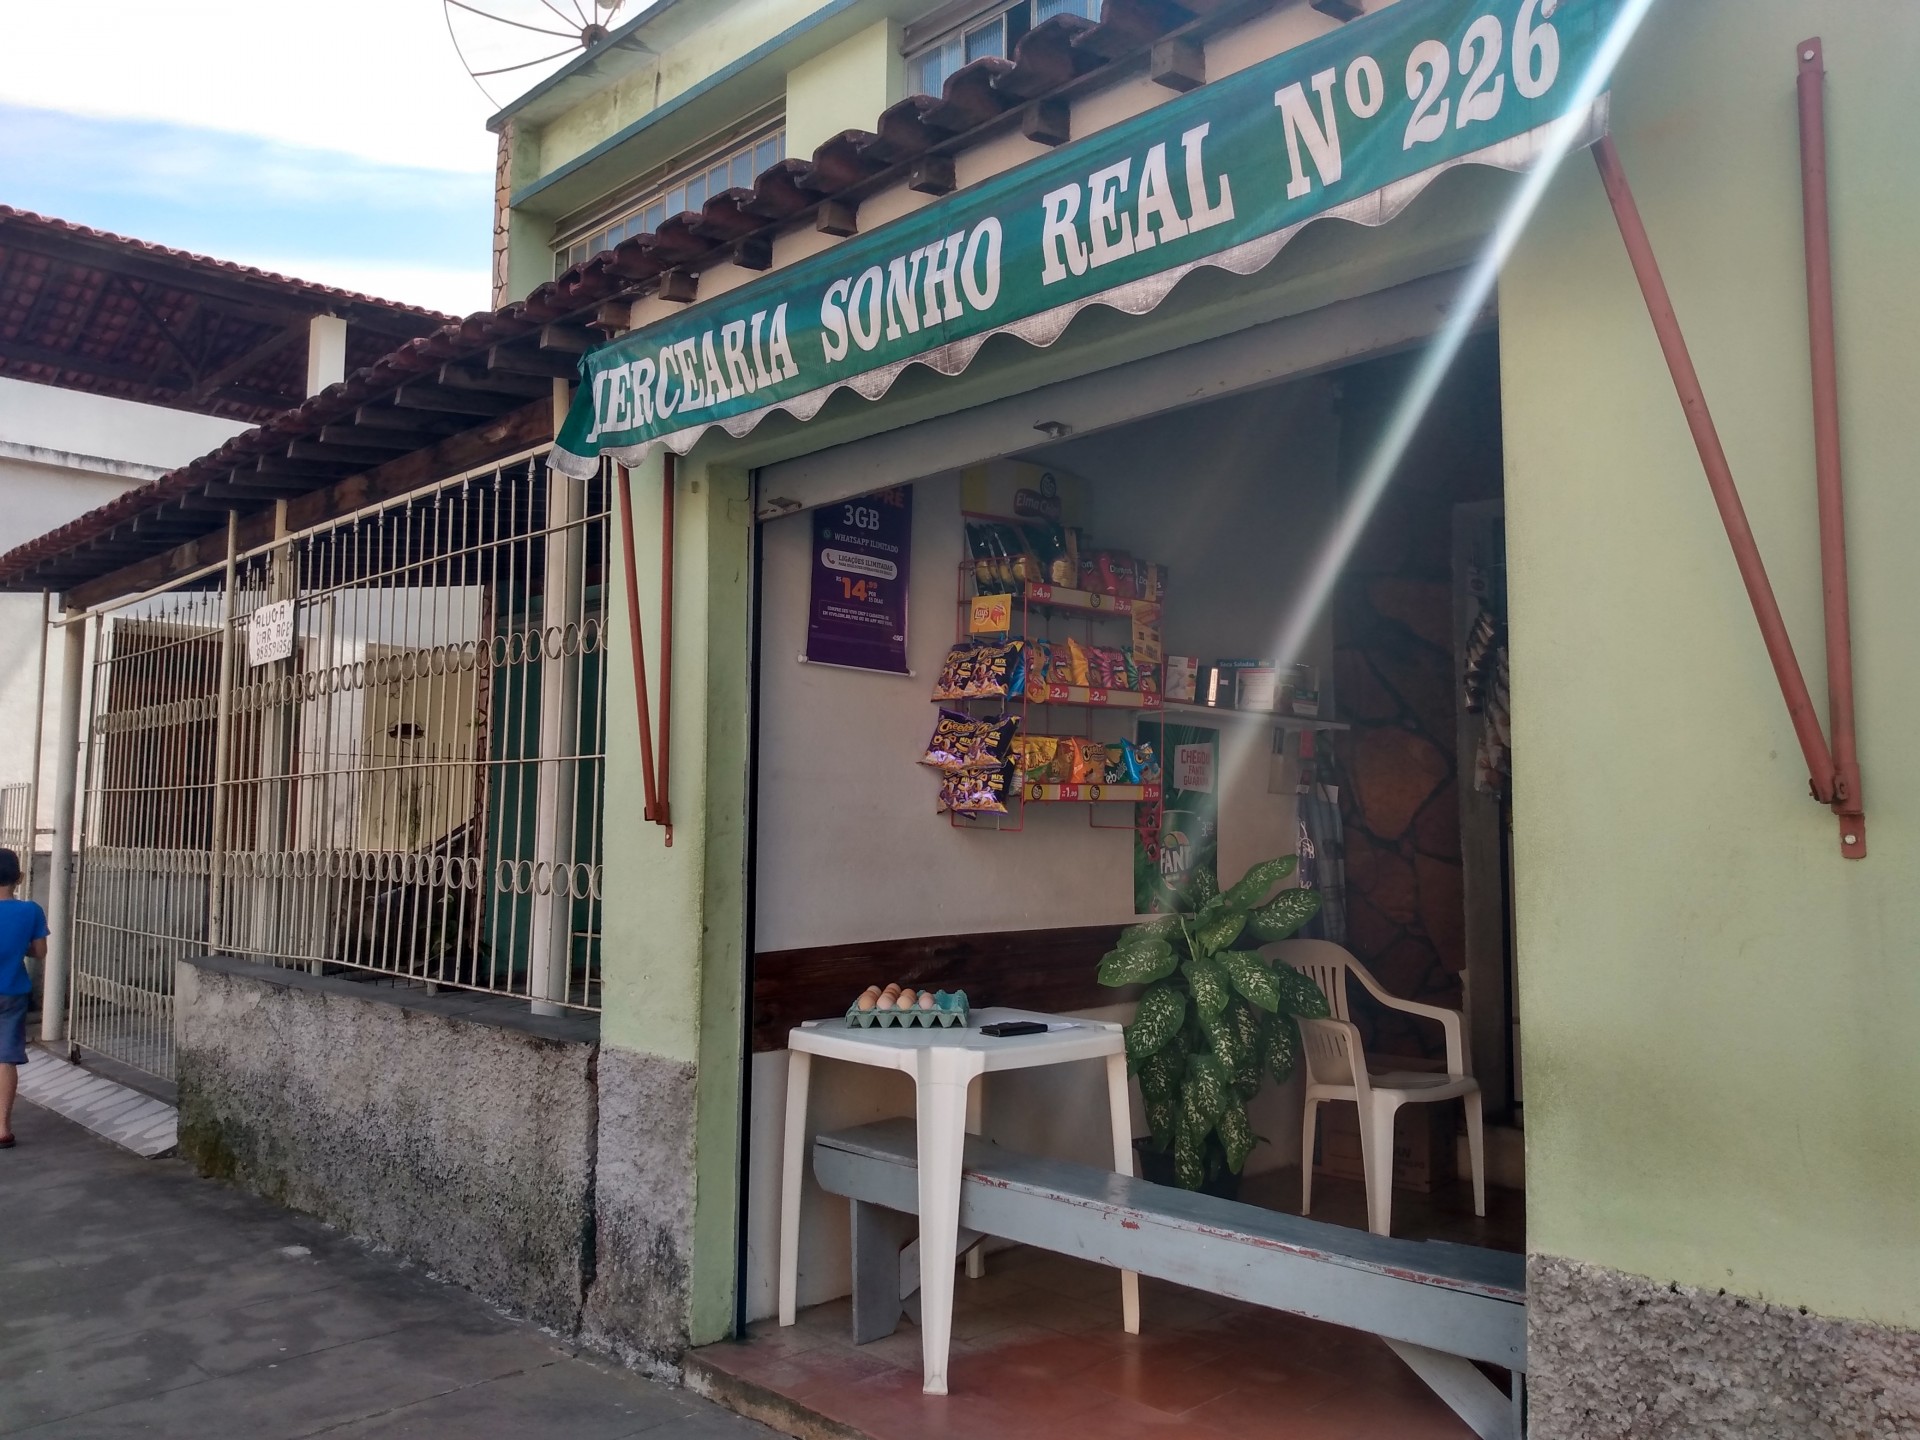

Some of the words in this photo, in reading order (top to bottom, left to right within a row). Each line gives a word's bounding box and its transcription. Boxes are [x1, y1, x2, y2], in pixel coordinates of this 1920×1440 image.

[820, 216, 1003, 363] SONHO
[1041, 121, 1235, 286] REAL
[1402, 0, 1560, 151] 226
[843, 504, 880, 531] 3GB
[834, 532, 869, 546] WHATSAPP
[870, 540, 899, 554] ILIMITADO
[865, 559, 894, 572] ILIMITADAS
[256, 604, 285, 628] ALUGA
[1160, 844, 1195, 875] FANT
